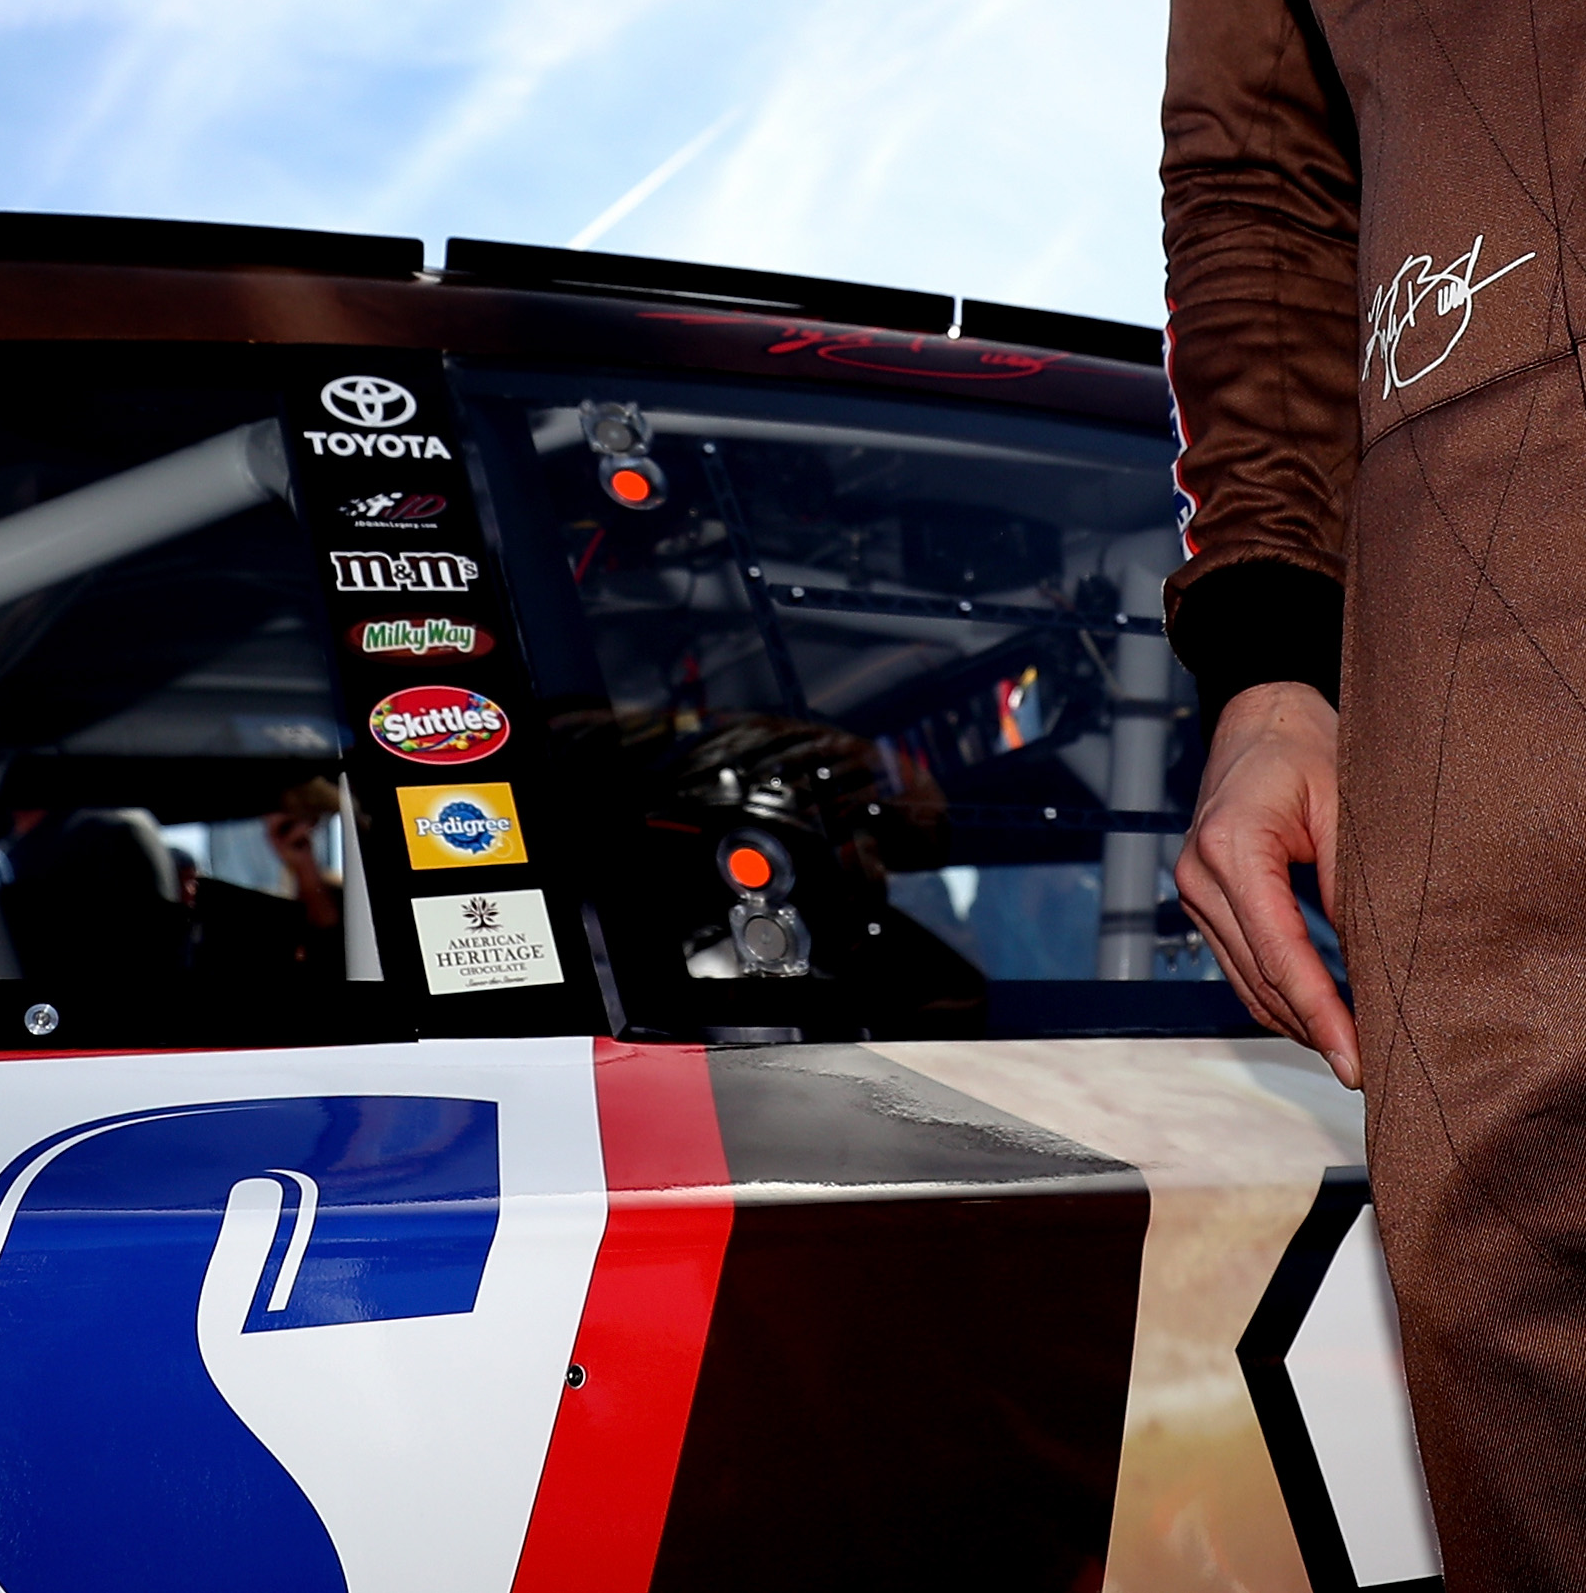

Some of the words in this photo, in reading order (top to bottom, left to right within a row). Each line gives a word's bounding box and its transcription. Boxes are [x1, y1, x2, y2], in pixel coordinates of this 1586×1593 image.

[303, 431, 452, 460] TOYOTA
[383, 705, 502, 743] Skittles
[415, 815, 511, 836] Pedigree
[448, 933, 527, 950] AMERICAN
[435, 944, 545, 968] HERITAGE
[460, 962, 527, 977] CHOCOLATE
